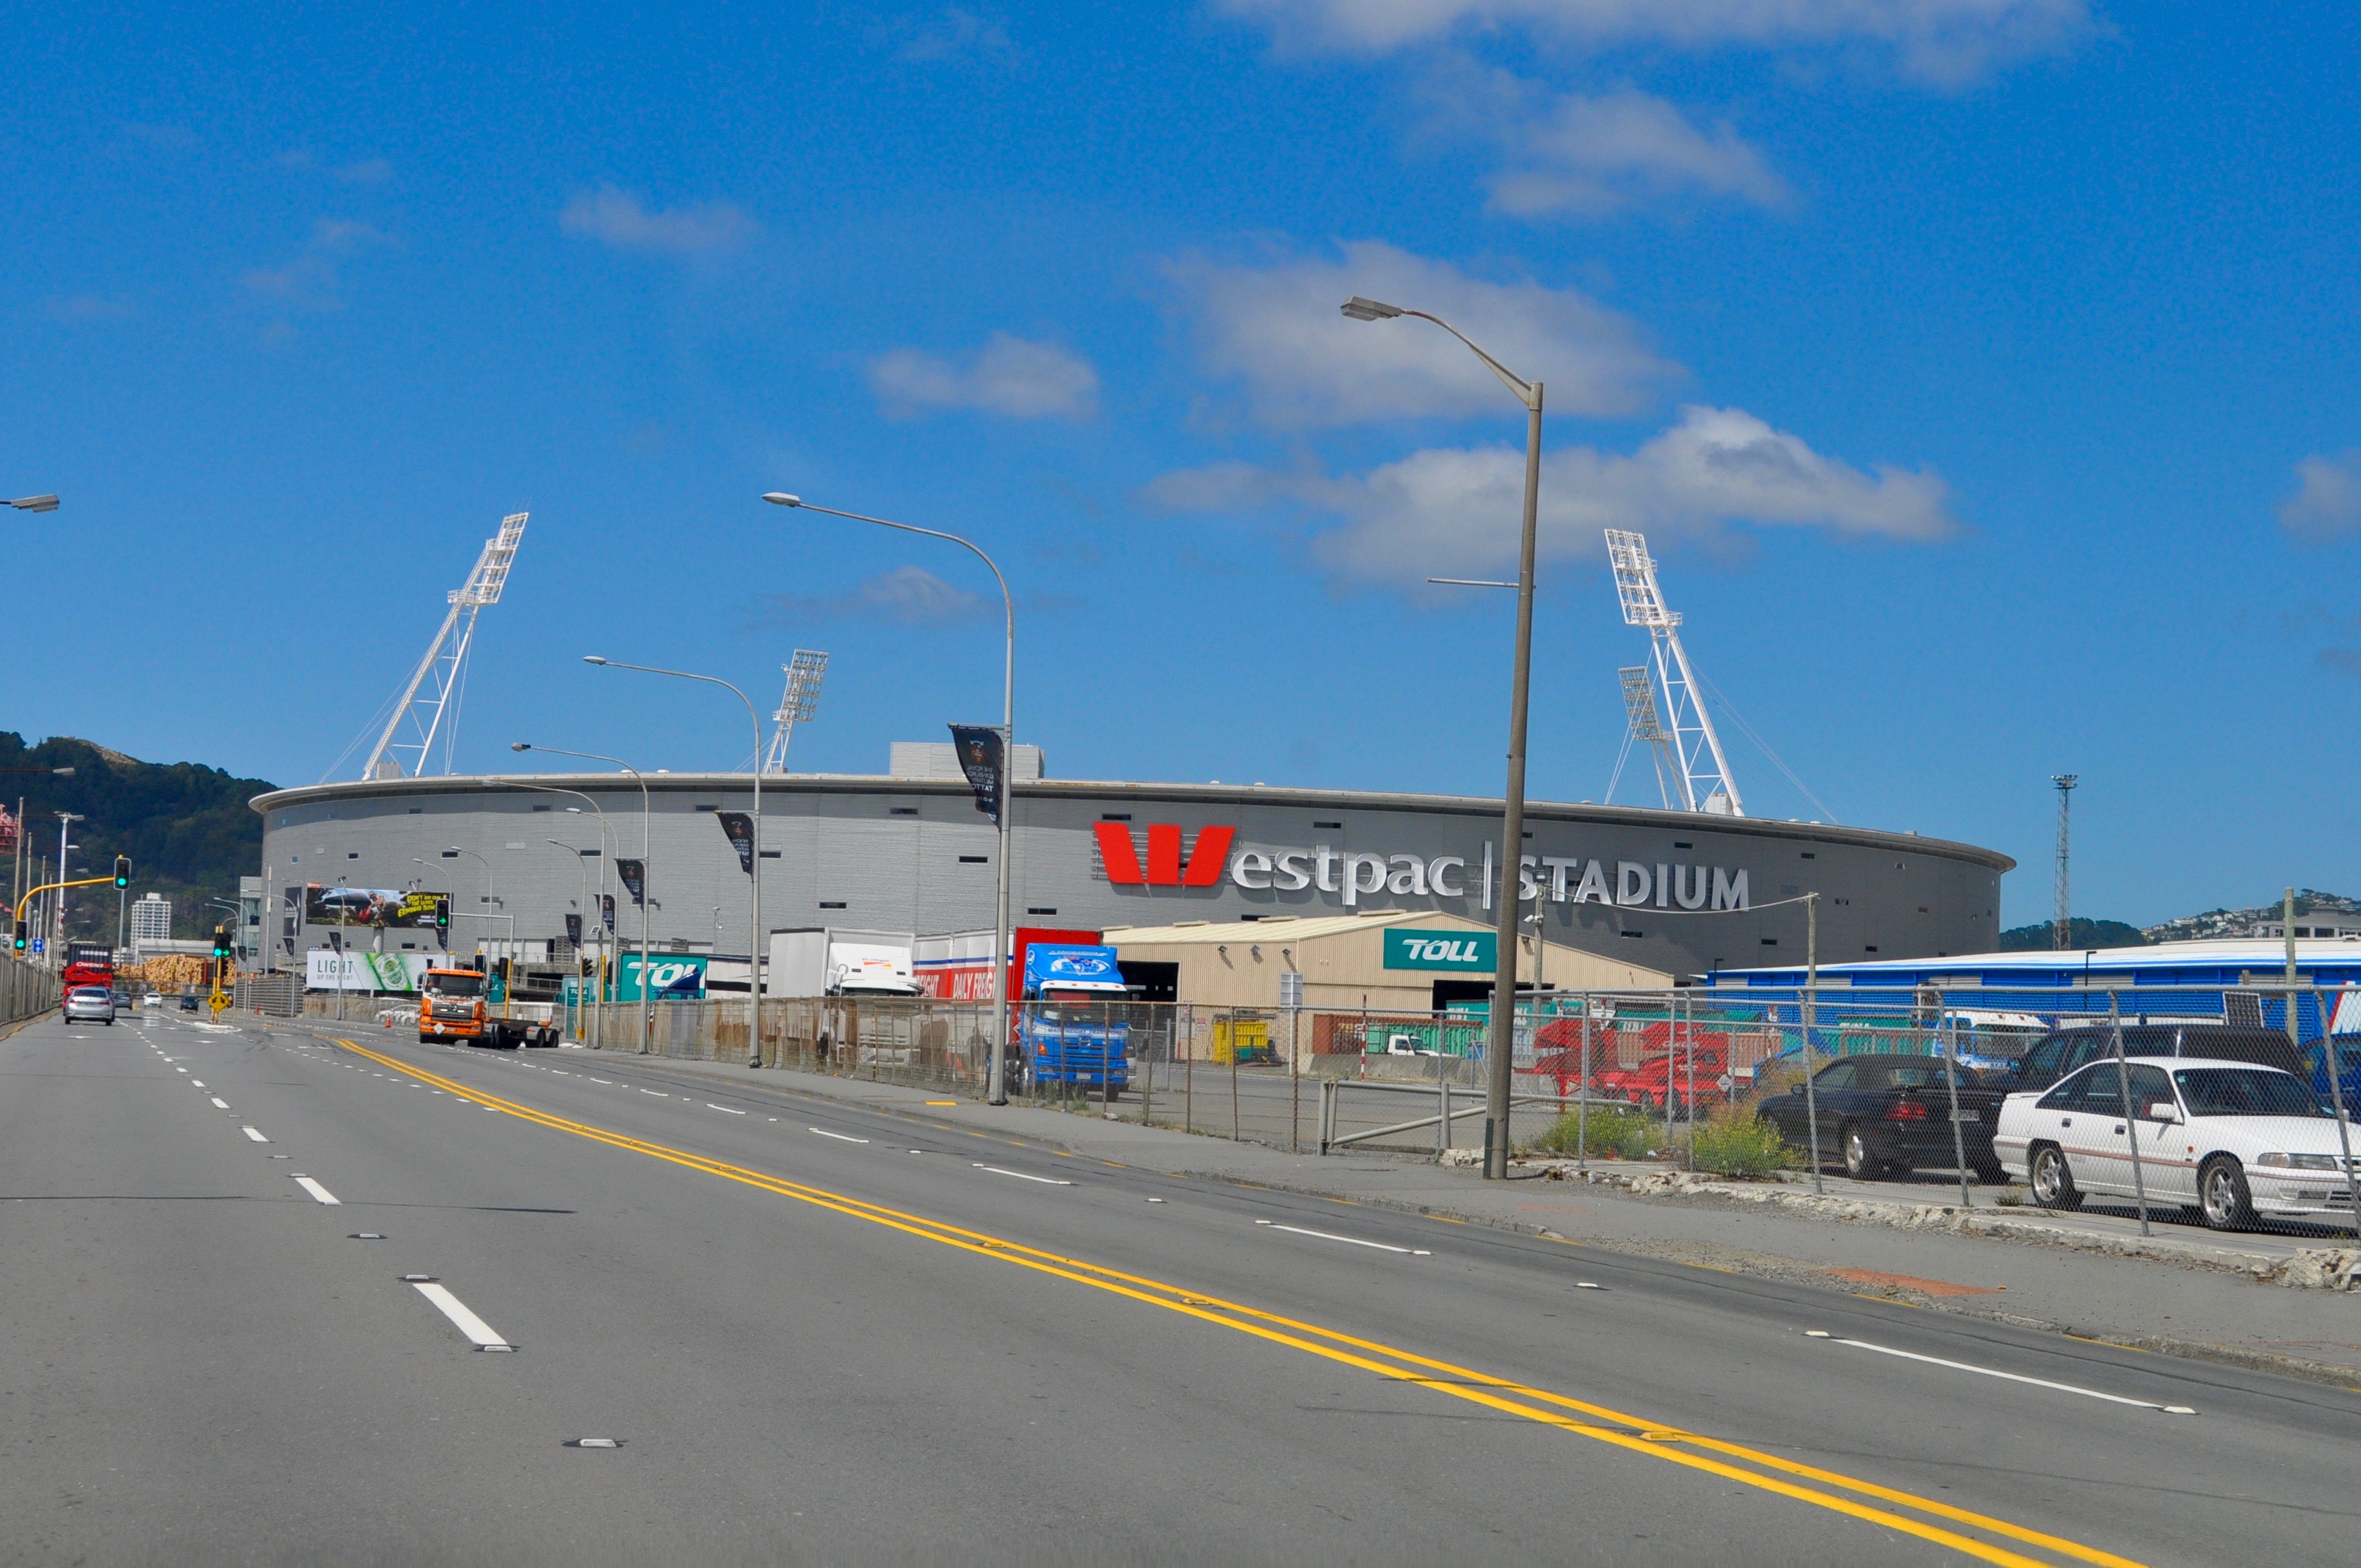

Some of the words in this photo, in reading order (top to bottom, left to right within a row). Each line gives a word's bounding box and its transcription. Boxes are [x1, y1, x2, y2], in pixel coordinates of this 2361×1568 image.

[1518, 854, 1749, 912] STADIUM
[1403, 939, 1479, 962] TOLL
[317, 959, 353, 974] LIGHT
[953, 973, 973, 1000] DAILY
